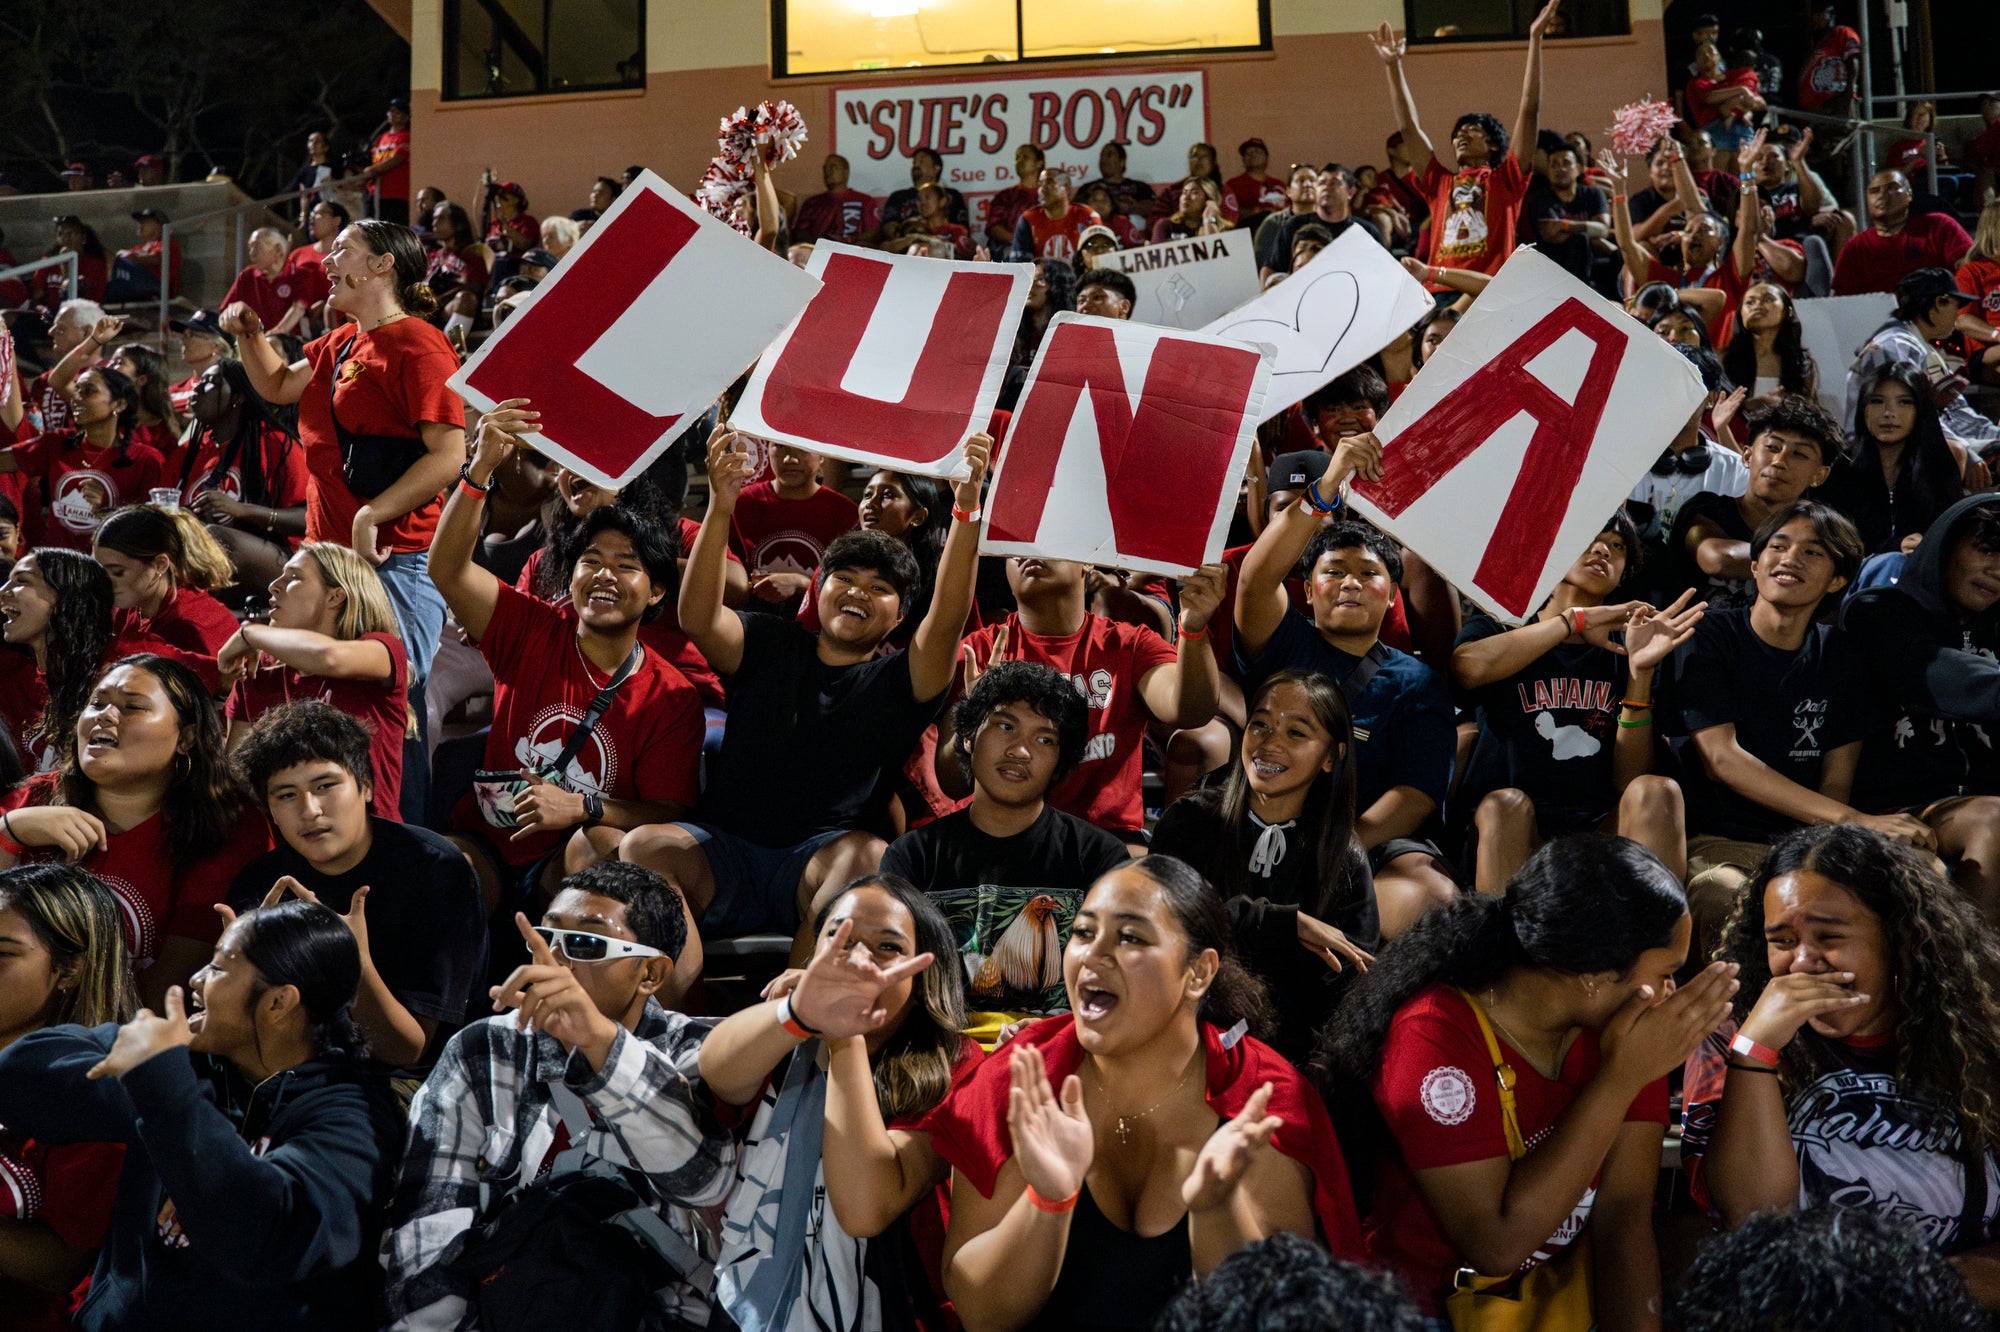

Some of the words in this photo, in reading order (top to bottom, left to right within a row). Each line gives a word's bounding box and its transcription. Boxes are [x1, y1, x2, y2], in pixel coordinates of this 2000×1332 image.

[845, 93, 1009, 160] "SUE'S
[1029, 83, 1193, 151] BOYS"
[951, 168, 986, 183] Sue
[995, 165, 1015, 180] D.
[1119, 238, 1230, 273] LAHAINA
